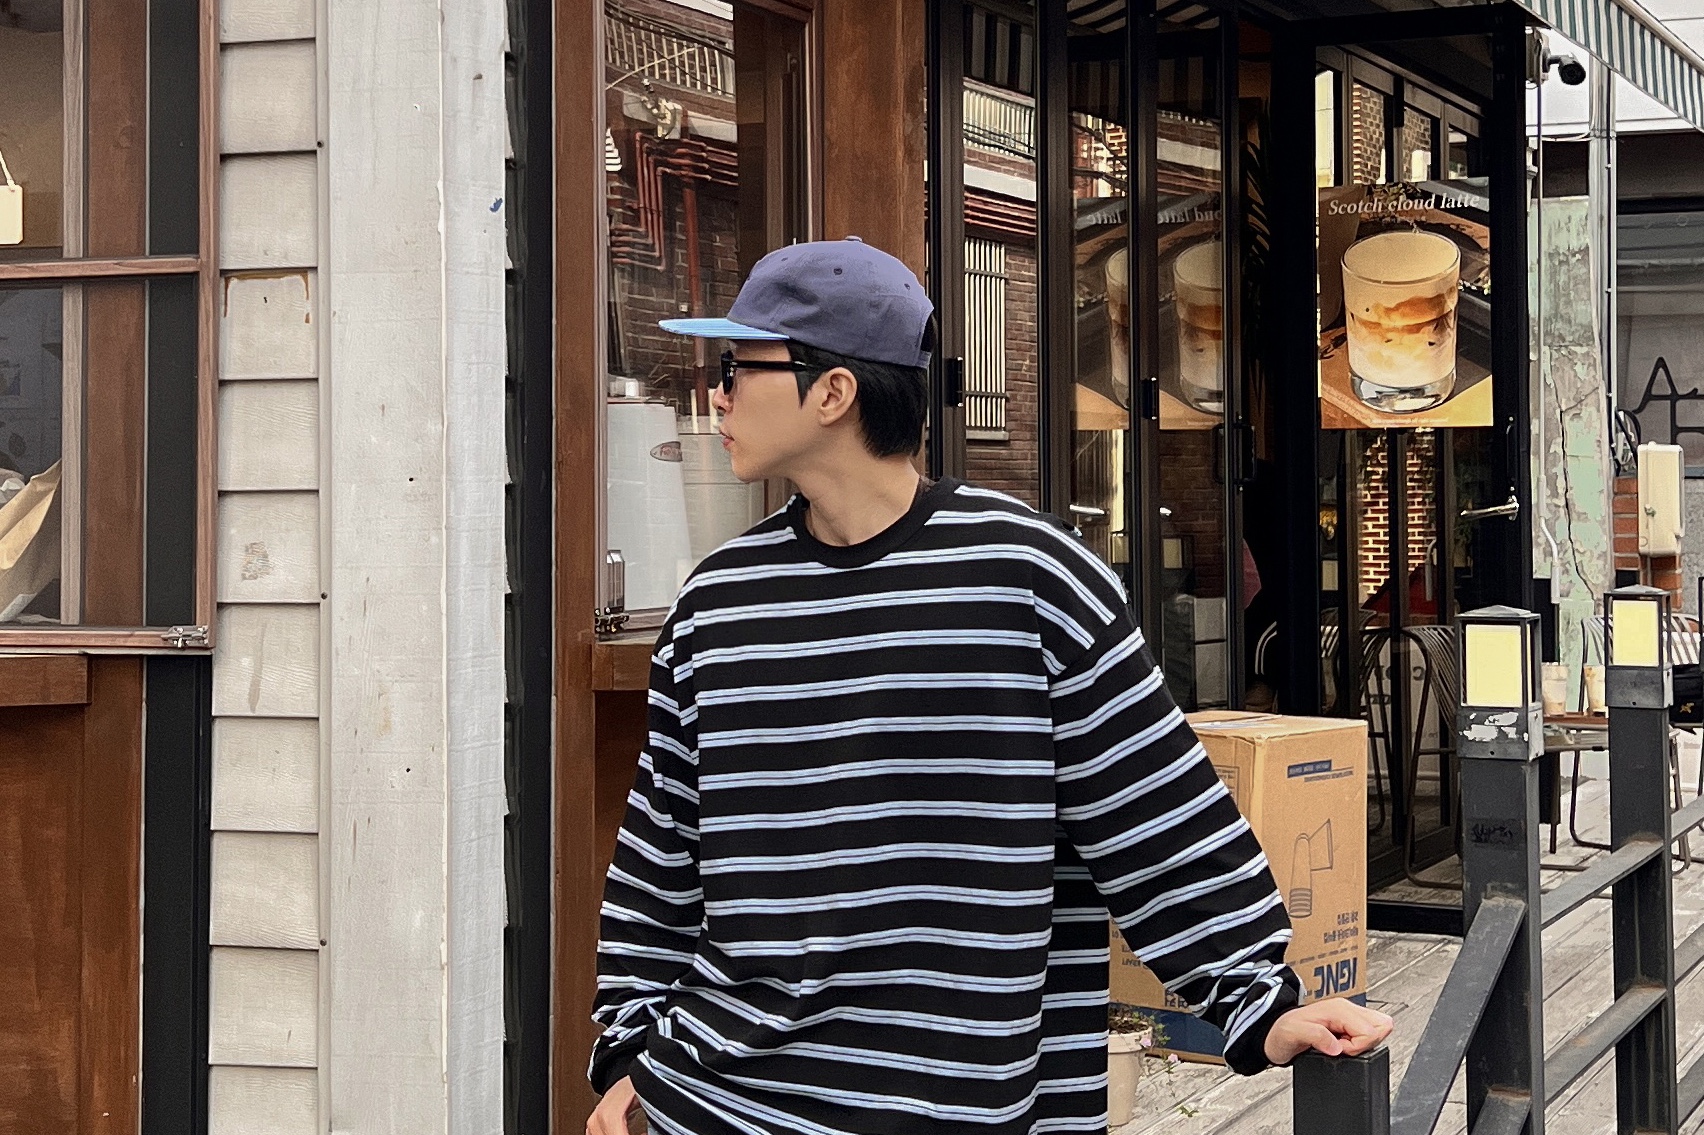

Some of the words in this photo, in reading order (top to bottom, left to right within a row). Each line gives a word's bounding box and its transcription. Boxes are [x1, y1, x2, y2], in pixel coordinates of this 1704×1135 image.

[1328, 198, 1383, 216] Scotch
[1388, 193, 1436, 212] cloud
[1440, 192, 1480, 209] latte
